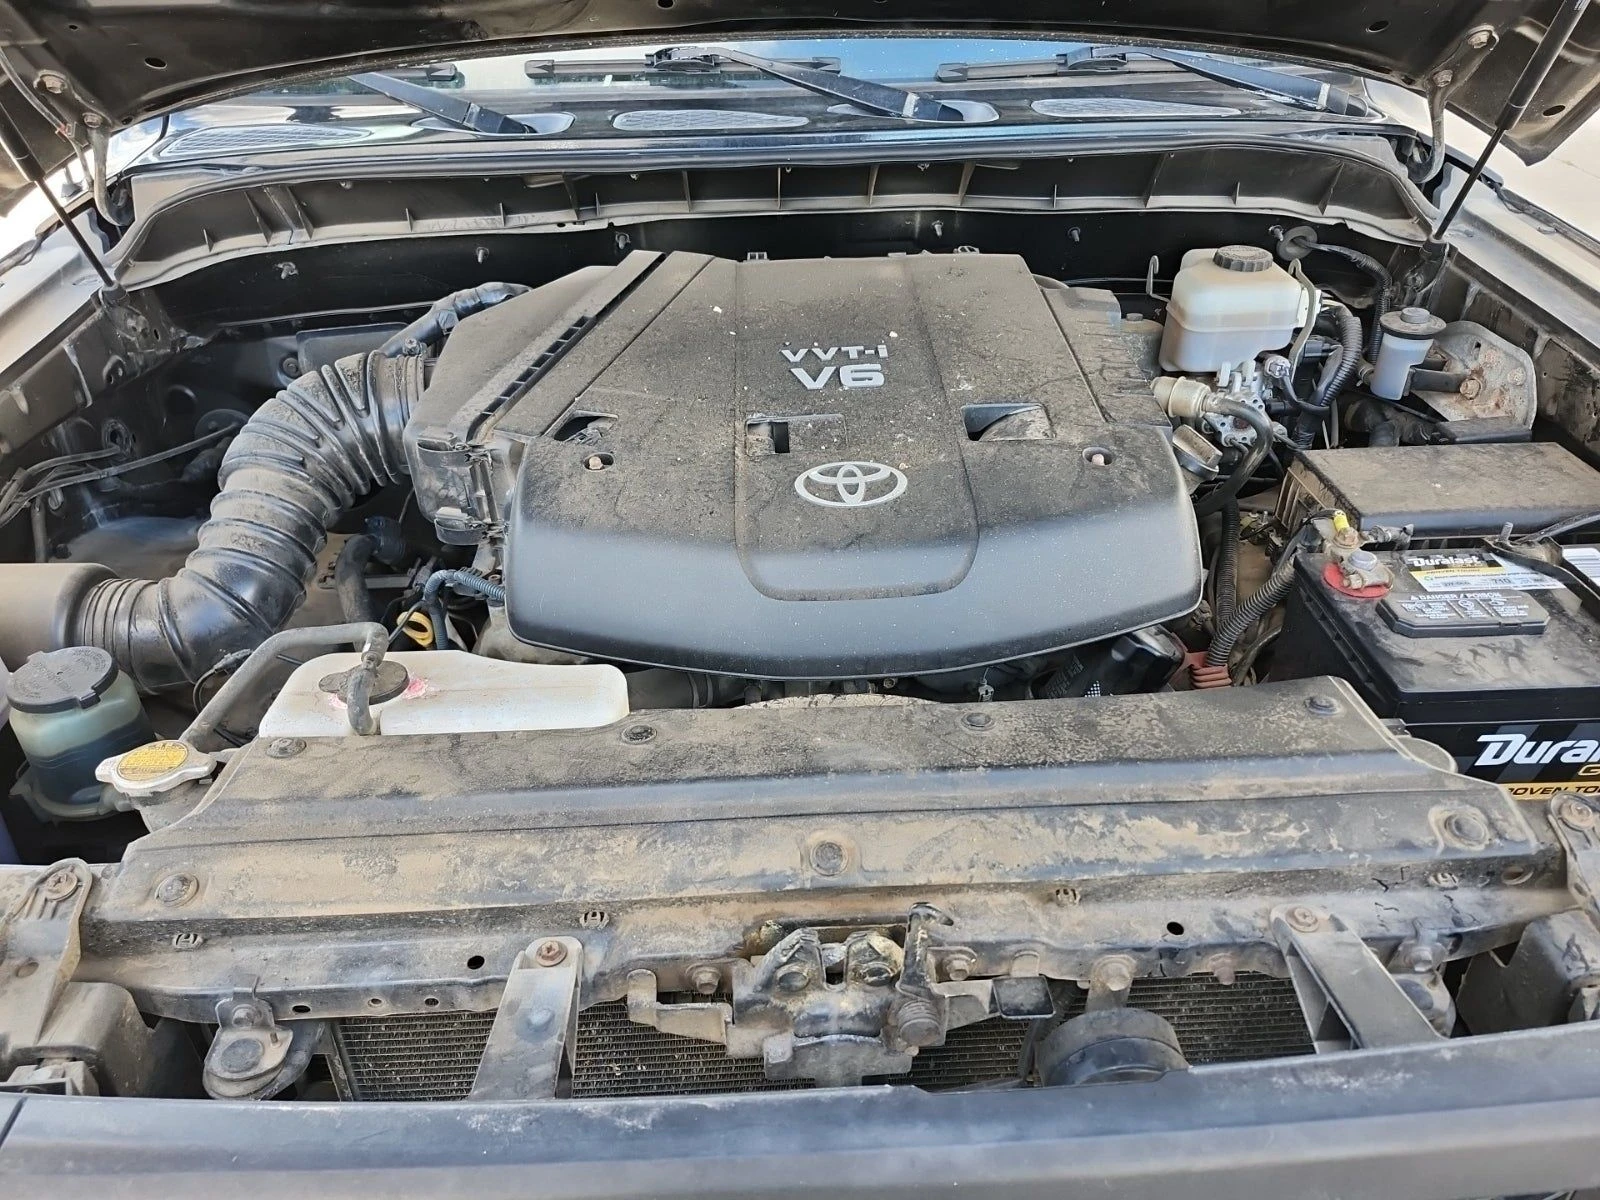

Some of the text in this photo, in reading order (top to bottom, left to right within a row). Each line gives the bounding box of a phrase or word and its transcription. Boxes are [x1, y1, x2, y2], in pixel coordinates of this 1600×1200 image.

[790, 363, 885, 390] V6
[1407, 555, 1479, 567] Duralast
[1419, 593, 1458, 601] DANGER
[1575, 785, 1600, 794] TO
